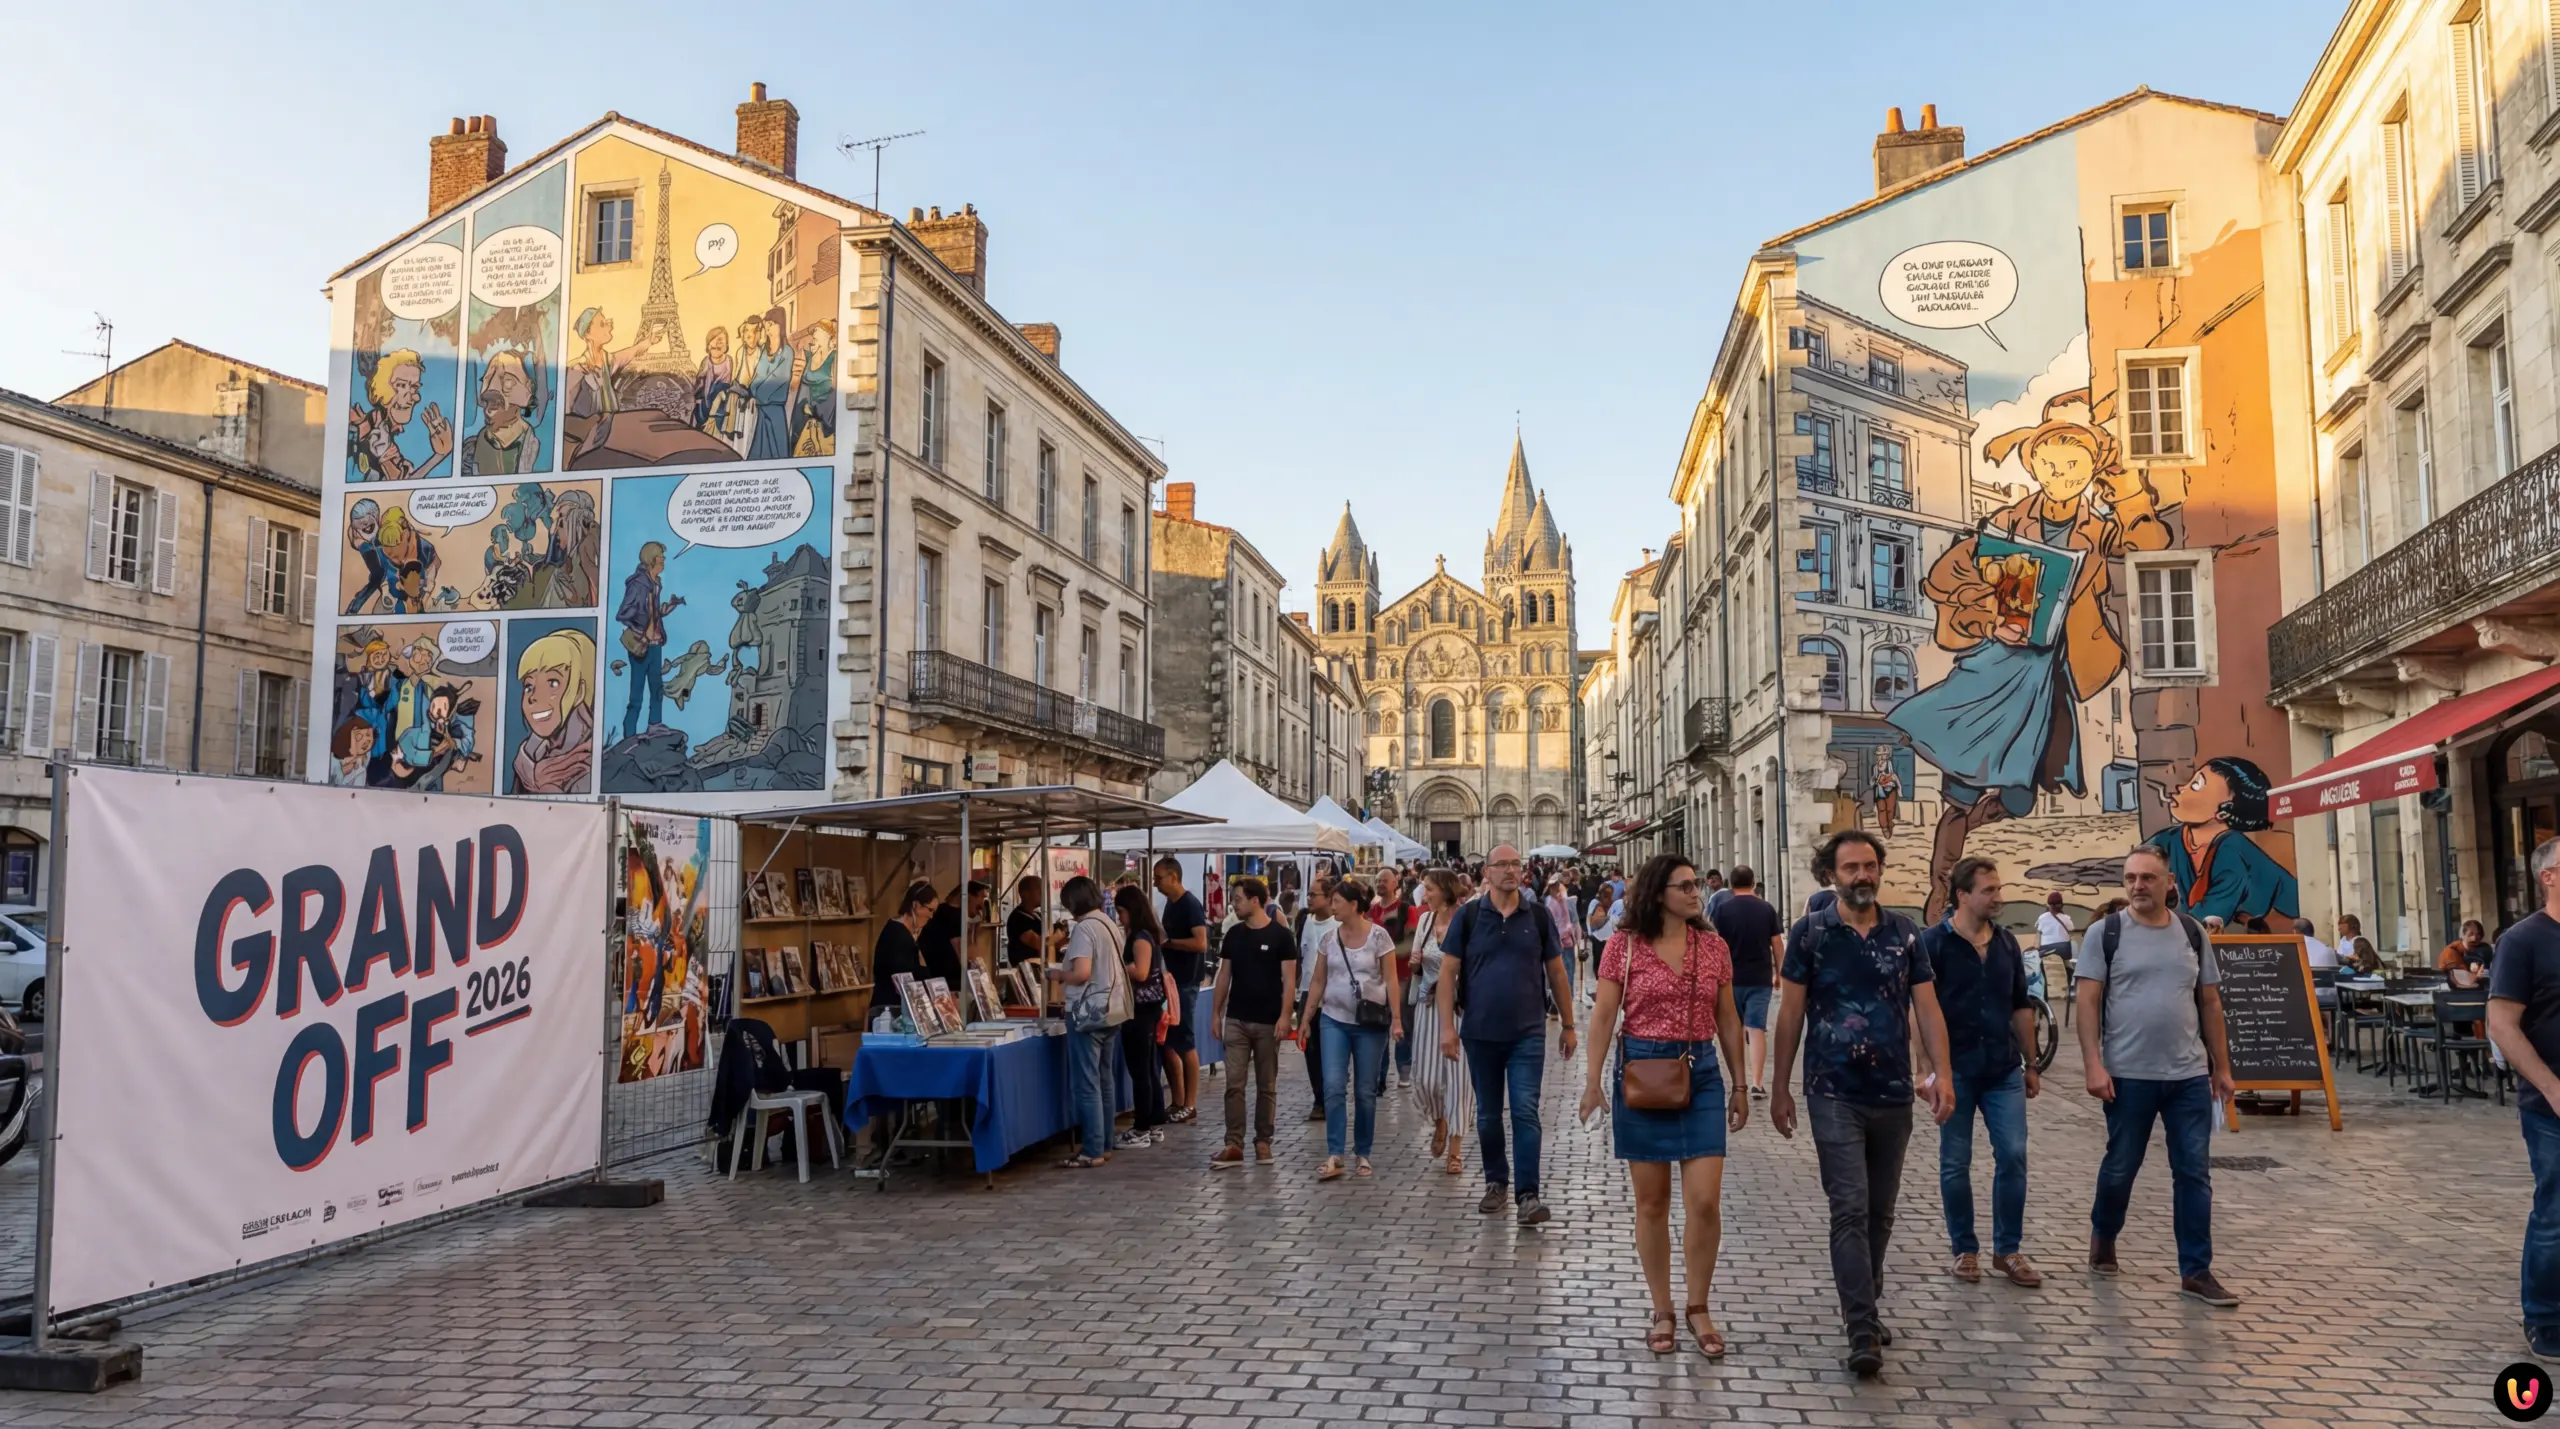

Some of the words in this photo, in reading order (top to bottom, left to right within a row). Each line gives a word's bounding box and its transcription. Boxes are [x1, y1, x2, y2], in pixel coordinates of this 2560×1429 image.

[194, 823, 529, 1027] GRAND
[272, 986, 460, 1172] OFF
[465, 955, 531, 1018] 2026
